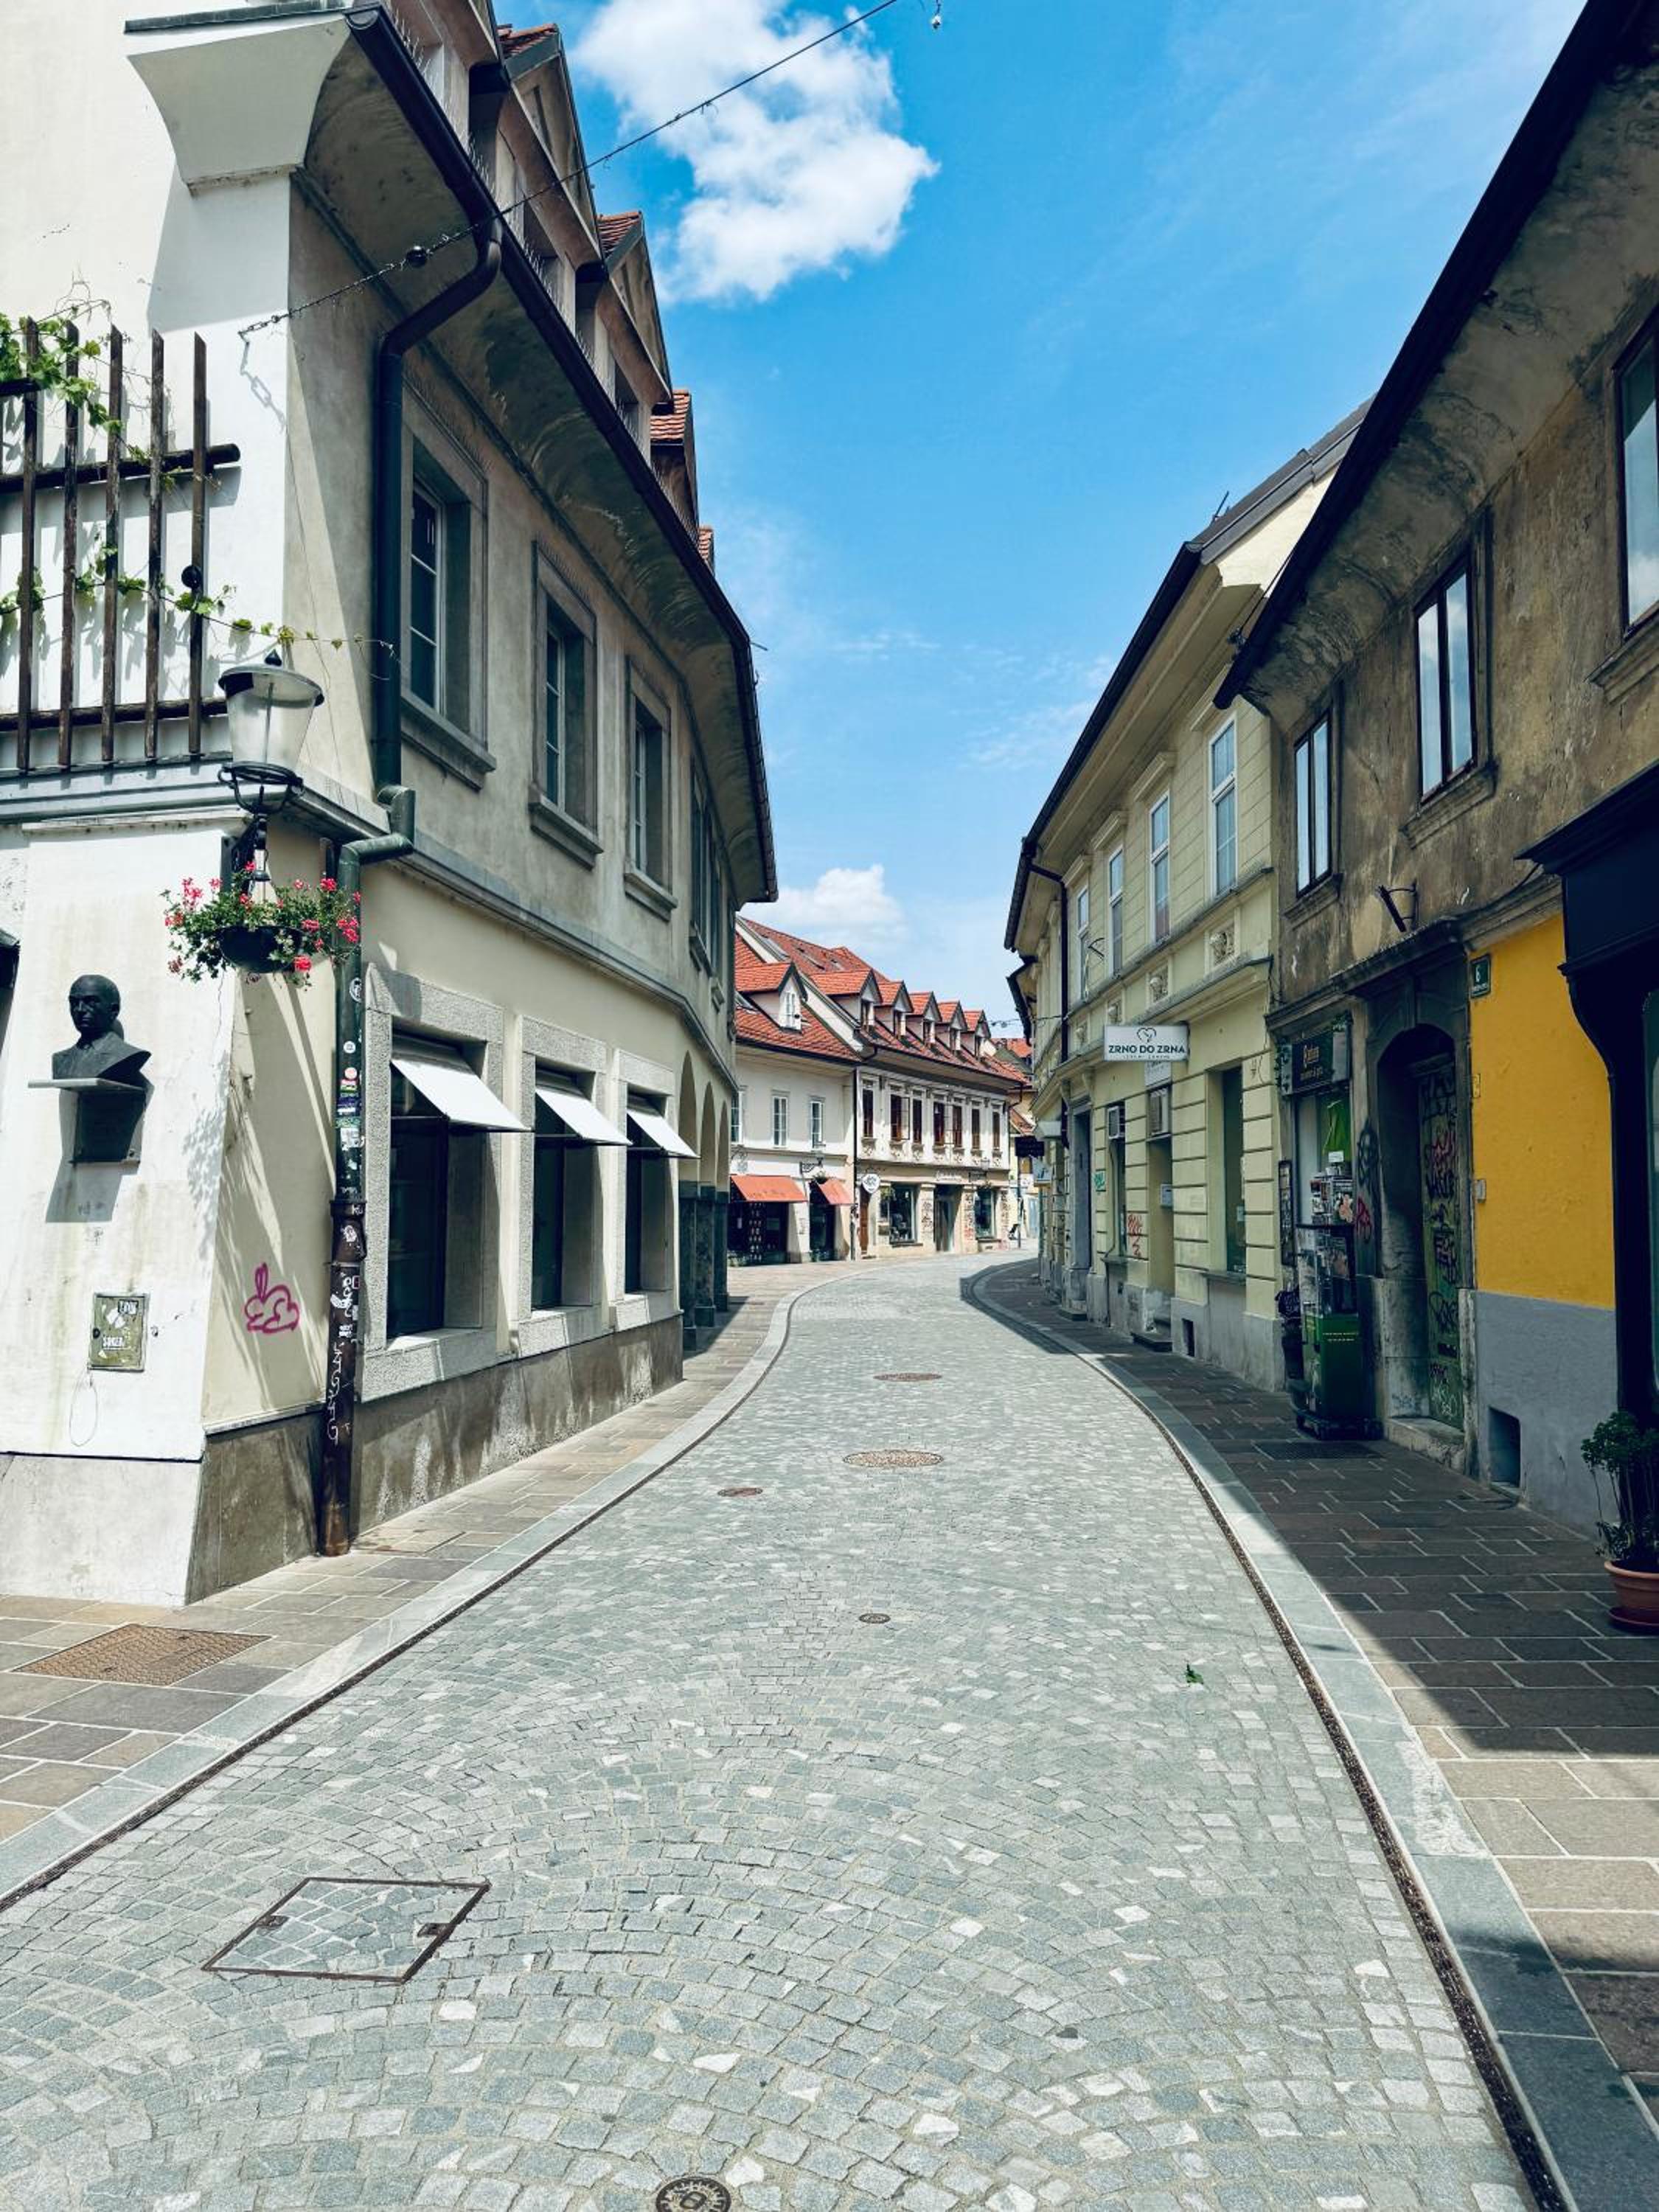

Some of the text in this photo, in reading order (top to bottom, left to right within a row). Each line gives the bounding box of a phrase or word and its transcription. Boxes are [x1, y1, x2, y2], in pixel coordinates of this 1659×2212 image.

[1475, 965, 1481, 983] 6
[1108, 1045, 1186, 1054] ZRNO DO ZRNA
